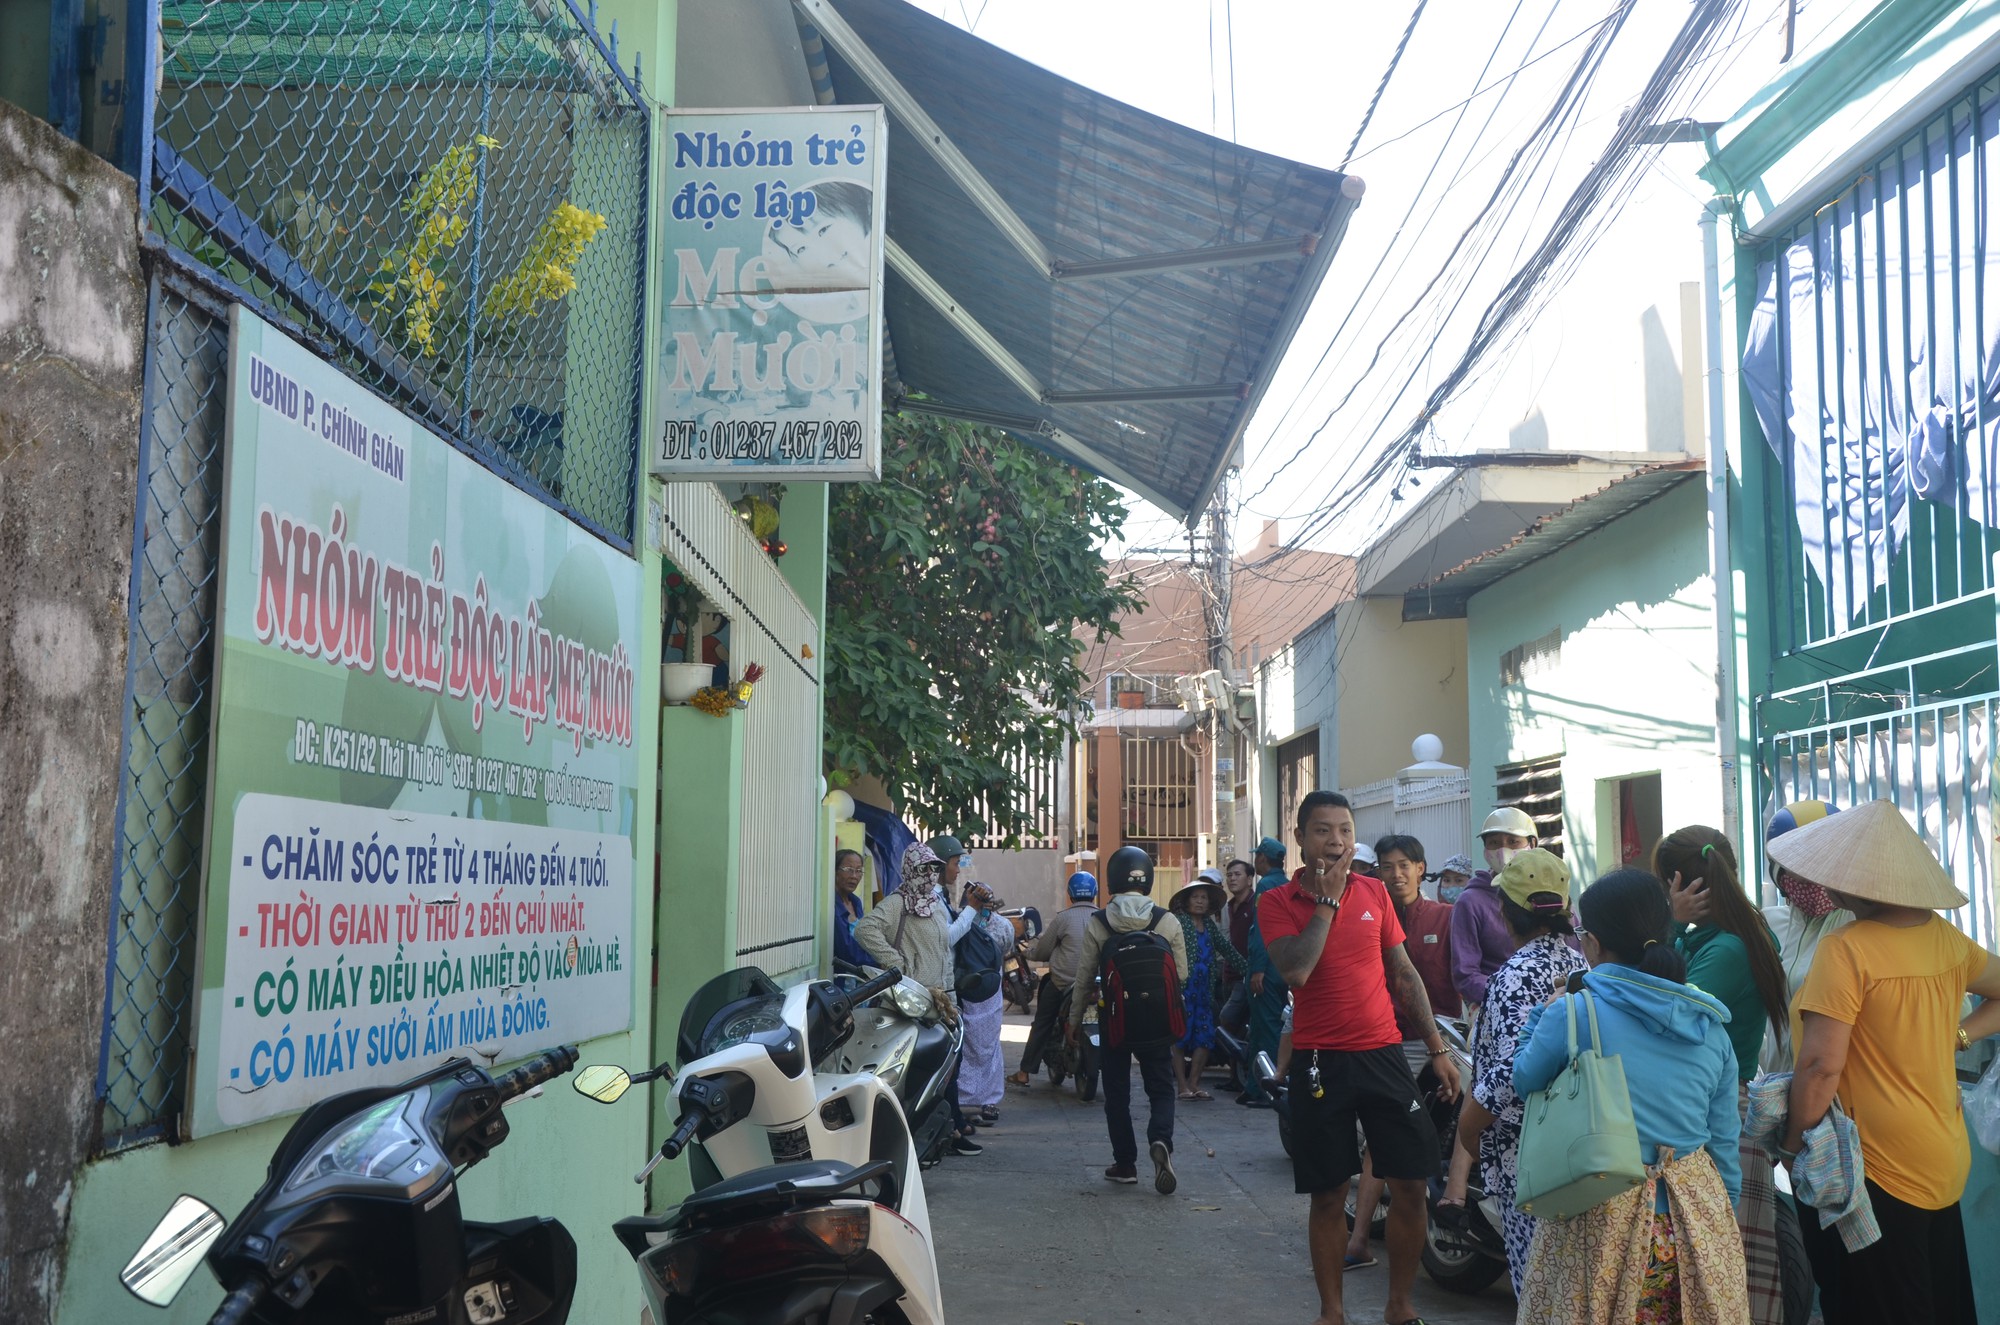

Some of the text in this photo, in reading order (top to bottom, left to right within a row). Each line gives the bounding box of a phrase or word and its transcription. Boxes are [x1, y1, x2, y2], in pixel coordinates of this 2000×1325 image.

[673, 124, 866, 169] Nhóm trẻ
[672, 180, 817, 230] độc lập
[670, 247, 779, 327] Mẹ
[669, 320, 861, 392] Mười
[250, 356, 404, 481] UBND P. CHÍNH GIÁN
[710, 420, 777, 460] 01237
[779, 420, 820, 460] 467
[823, 420, 862, 460] 262
[255, 507, 633, 752] NHÓM TRẺ ĐỘC LẬP MẸ MƯỜI
[294, 718, 320, 764] ĐC:
[323, 724, 376, 774] K251/32
[379, 737, 404, 779] Thái
[407, 743, 424, 791] Thị
[426, 745, 443, 786] Bôi
[453, 753, 474, 789] SĐT:
[475, 756, 503, 793] 01237
[505, 762, 520, 797] 467
[522, 765, 537, 800] 262
[261, 826, 609, 887] CHĂM SÓC TRẺ TỪ 4 THÁNG ĐẾN 4 TUỔI.
[258, 889, 321, 948] THỜI
[329, 903, 389, 946] GIAN
[396, 892, 421, 943] TỪ
[425, 891, 461, 942] THỨ
[465, 903, 475, 938] 2
[480, 887, 511, 937] ĐẾN
[516, 890, 547, 935] CHỦ
[254, 956, 299, 1018] CÓ
[307, 954, 363, 1012] MÁY
[370, 943, 417, 1005] ĐIỀU
[424, 948, 464, 999] HÒA
[470, 942, 514, 998] NHIỆT
[518, 941, 540, 993] ĐỘ
[577, 936, 603, 977] MÙA
[606, 935, 622, 972] HÈ.
[250, 993, 550, 1087] CÓ MÁY SƯỞI ẤM MÙA ĐÔNG.
